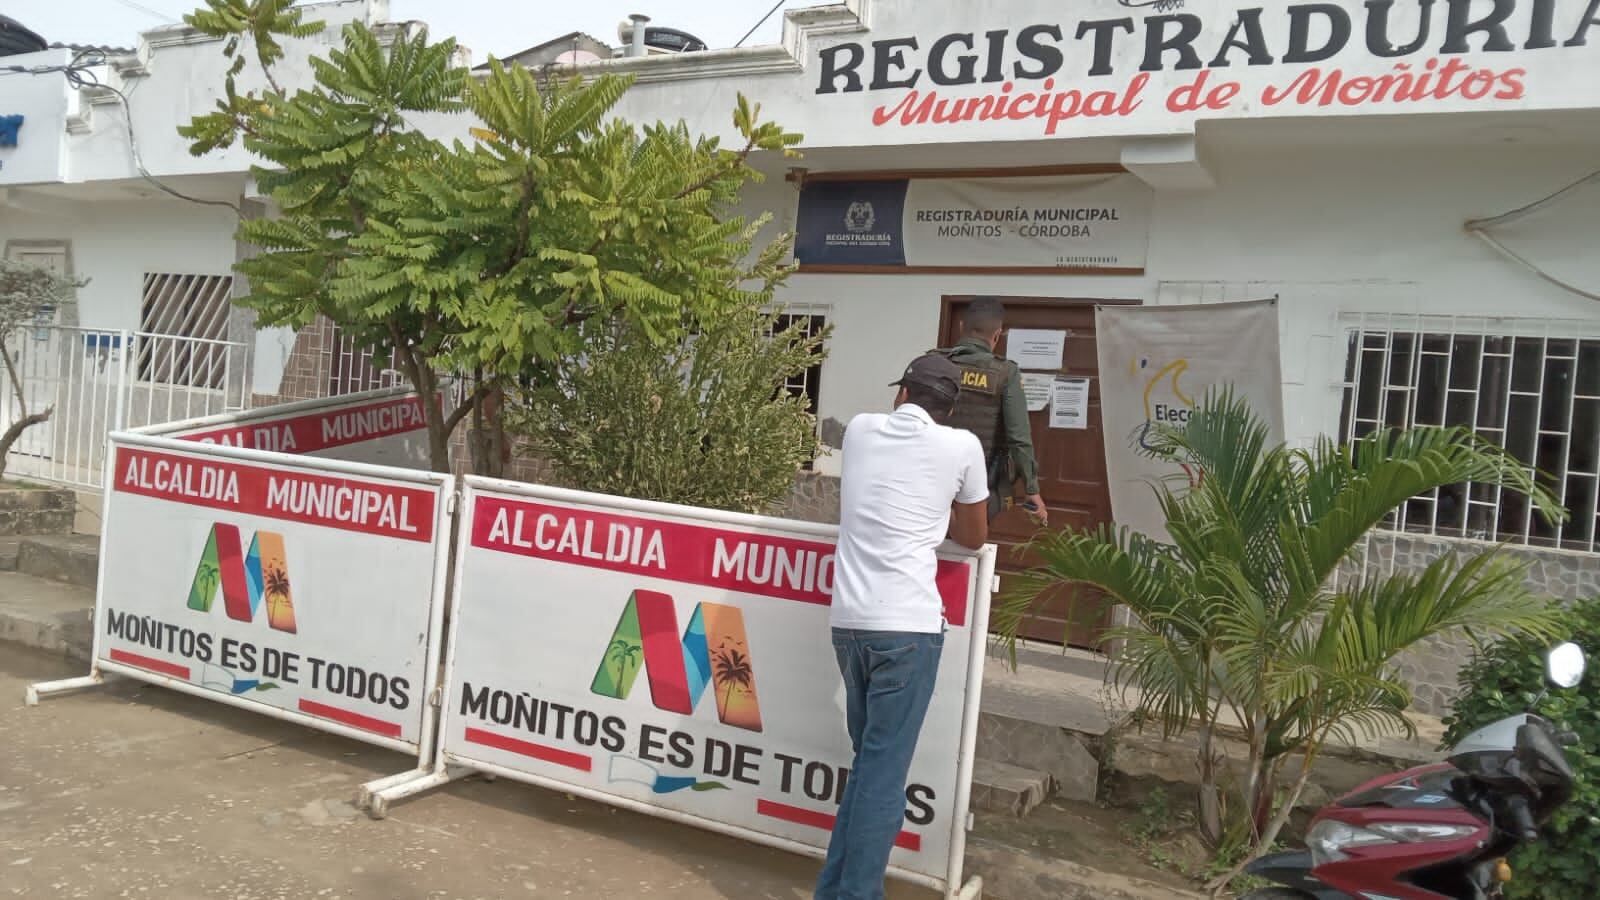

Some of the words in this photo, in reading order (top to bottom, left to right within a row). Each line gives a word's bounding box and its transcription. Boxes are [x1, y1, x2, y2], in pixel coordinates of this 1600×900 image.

[872, 72, 1150, 136] Municipal
[1166, 70, 1241, 113] de
[1261, 57, 1528, 107] Moñitos
[916, 206, 1029, 222] REGISTRADURÍA
[1033, 208, 1119, 221] MUNICIPAL
[937, 222, 1002, 237] MOÑITOS
[1018, 222, 1091, 237] CÓRDOBA
[124, 455, 240, 504] ALCALDIA
[266, 476, 418, 533] MUNICIPAL
[487, 507, 667, 571] ALCALDIA
[711, 537, 836, 596] MUNIC
[107, 608, 213, 663] MOÑITOS
[221, 637, 257, 674] ES
[262, 647, 299, 684] DE
[307, 656, 410, 711] TODOS
[459, 682, 627, 753] MOÑITOS
[638, 725, 695, 770] ES
[704, 738, 761, 786] DE
[773, 753, 937, 826] TOS
